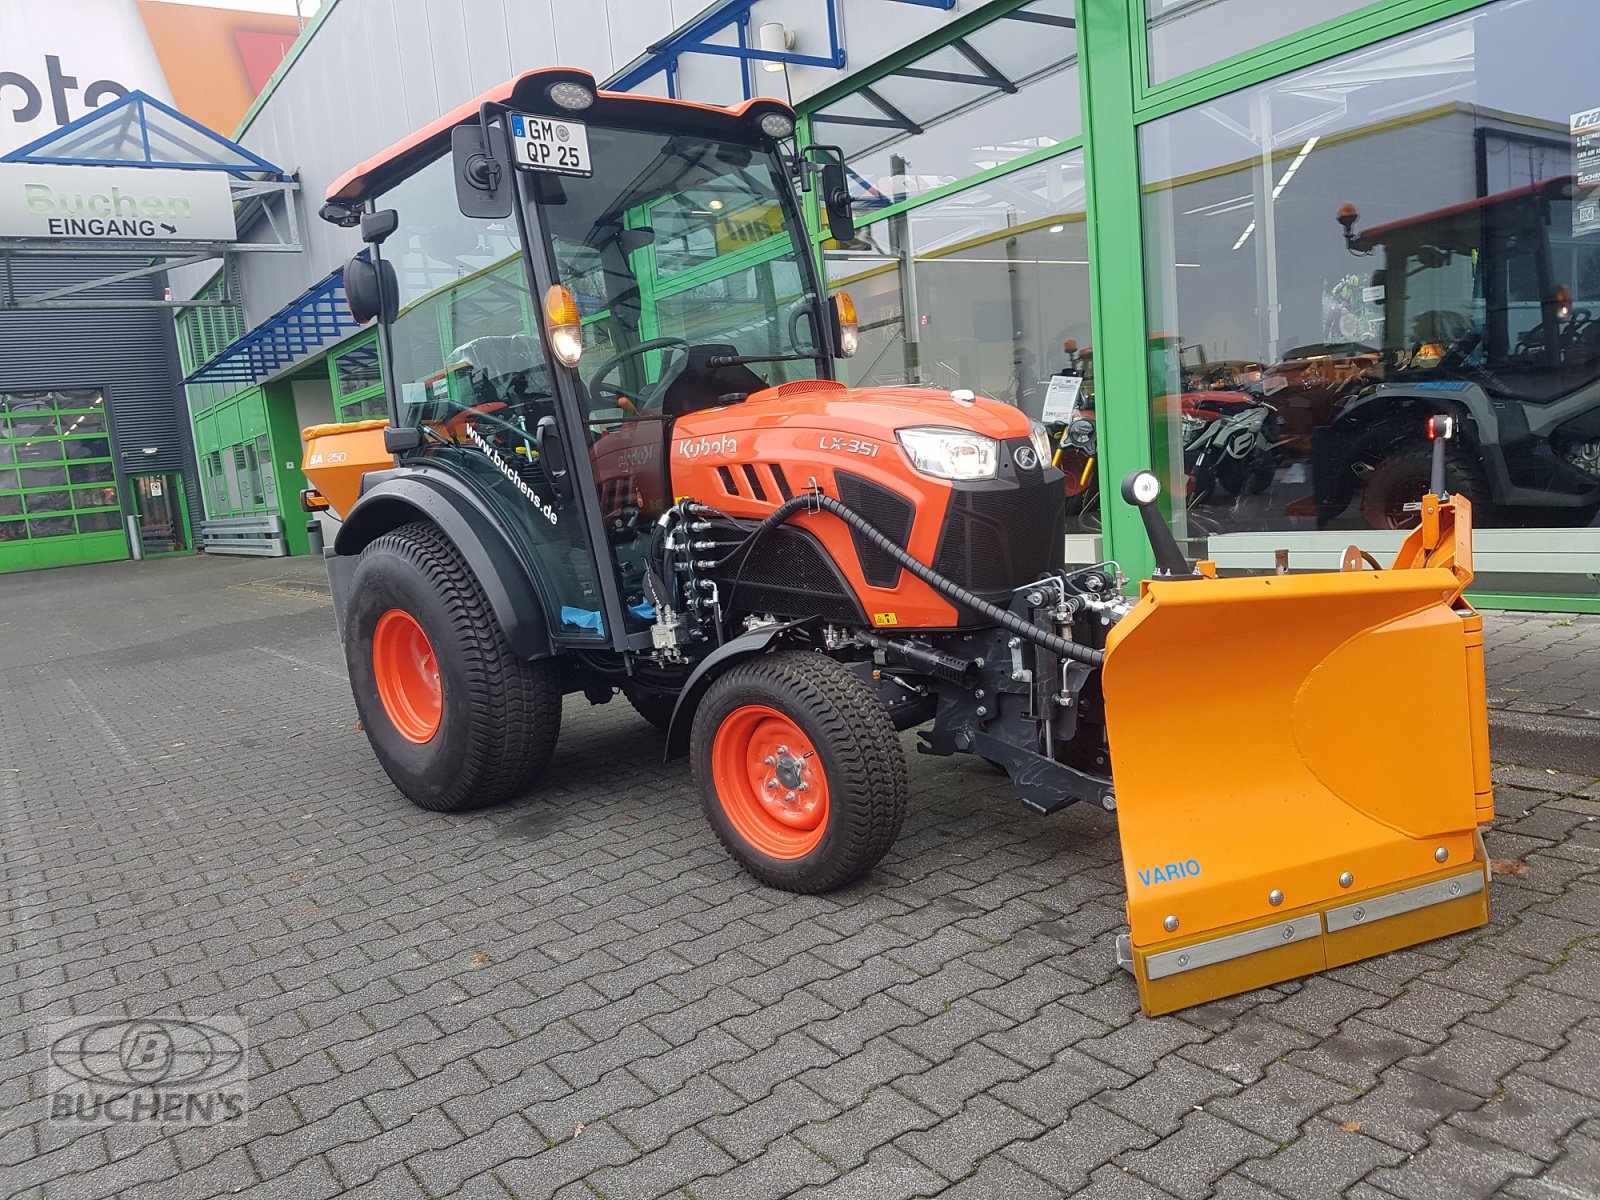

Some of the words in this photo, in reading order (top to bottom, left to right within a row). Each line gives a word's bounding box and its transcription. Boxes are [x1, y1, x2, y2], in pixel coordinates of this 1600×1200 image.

[528, 119, 554, 142] GM
[527, 141, 551, 163] QP
[557, 146, 580, 167] 25
[25, 183, 192, 219] Buchen
[48, 218, 155, 236] EINGANG
[310, 454, 324, 465] SA
[327, 452, 347, 463] 250
[679, 434, 737, 459] Kubota
[466, 422, 558, 525] www.buchens.de
[1137, 859, 1201, 887] VARIO
